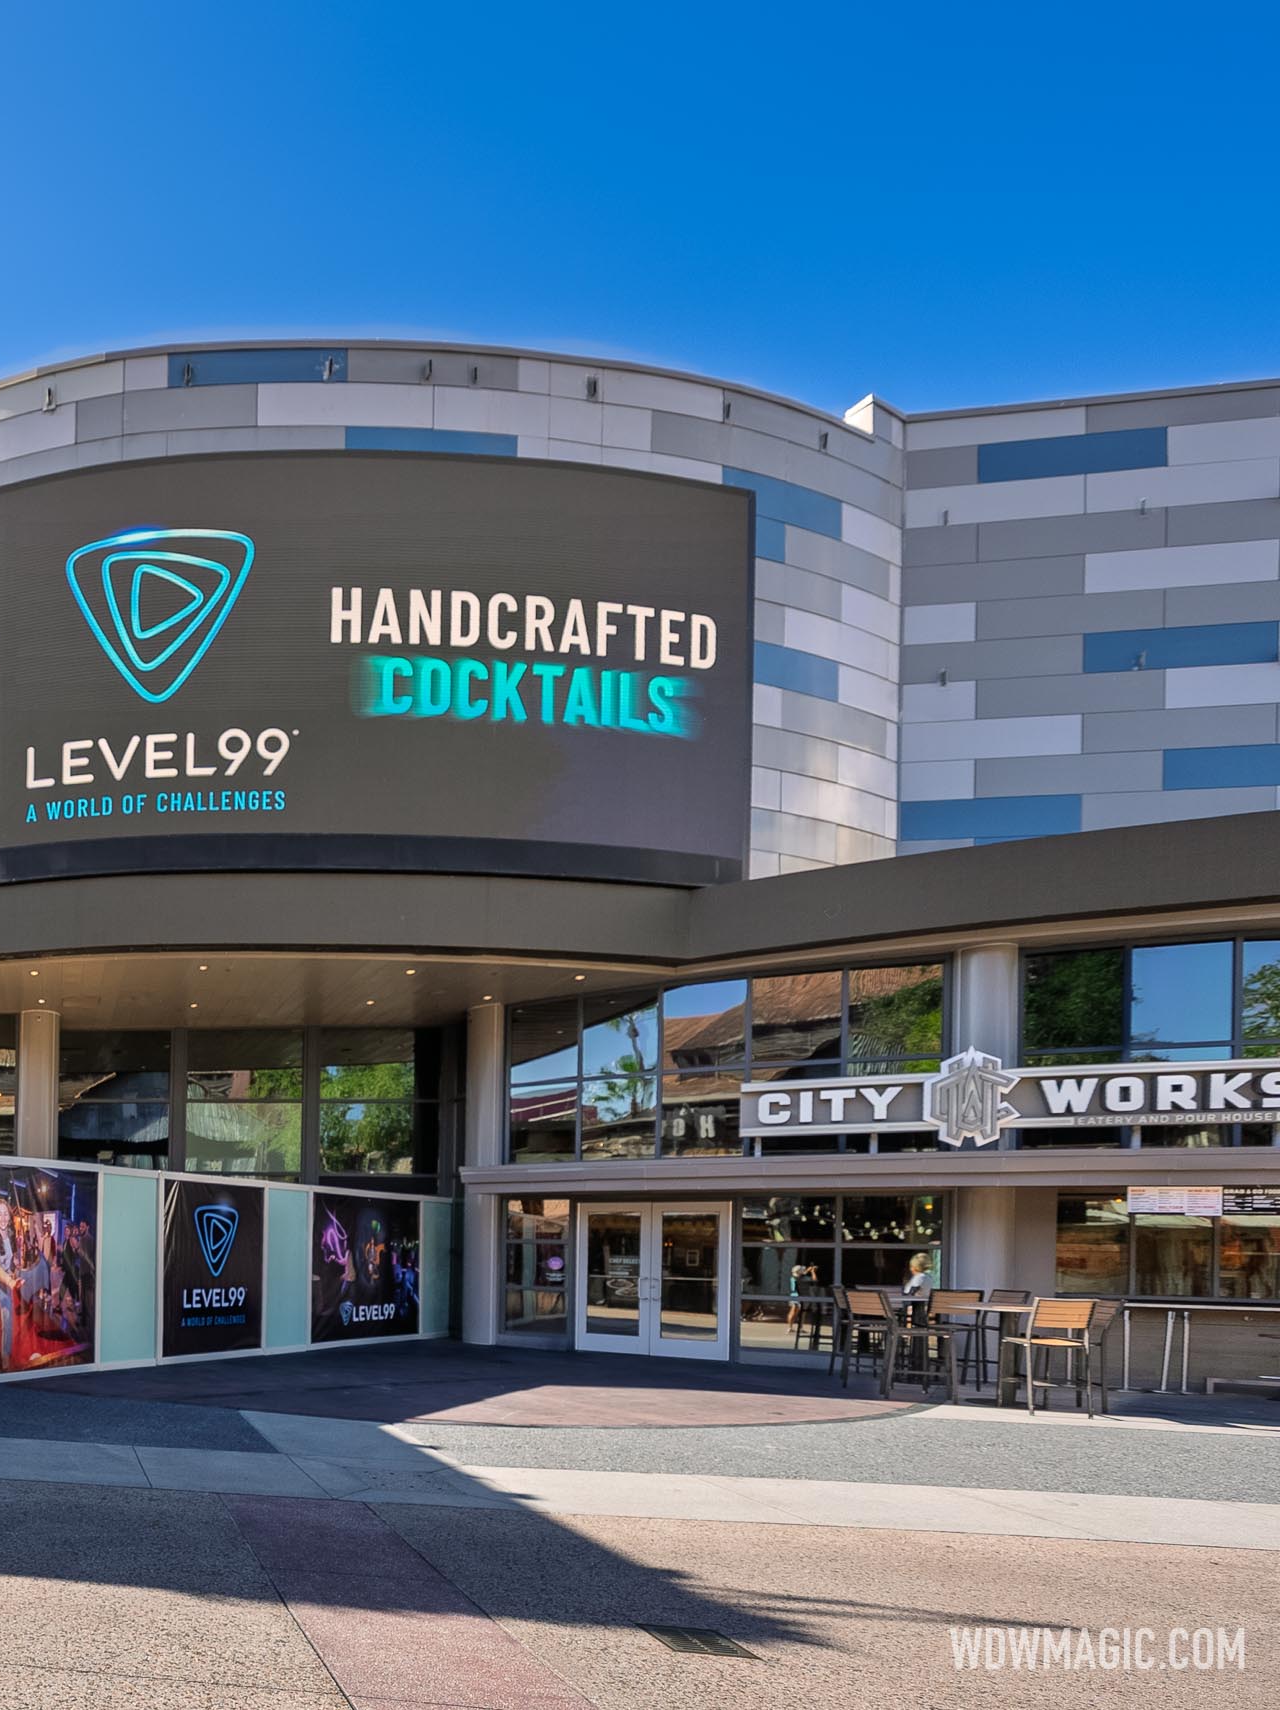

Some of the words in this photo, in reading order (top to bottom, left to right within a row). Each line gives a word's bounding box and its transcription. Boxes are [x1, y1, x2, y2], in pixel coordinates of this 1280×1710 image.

[330, 586, 718, 670] HANDCRAFTED
[368, 655, 686, 736] COCKTAILS
[25, 727, 290, 789] LEVEL99
[25, 803, 38, 823] A
[45, 796, 113, 821] WORLD
[122, 794, 148, 815] OF
[156, 789, 287, 813] CHALLENGES
[757, 1086, 904, 1125] CITY
[1077, 1115, 1134, 1127] EATERY
[1138, 1114, 1170, 1125] AND
[1175, 1112, 1217, 1124] POUR
[1221, 1111, 1273, 1122] HOUSE
[182, 1287, 245, 1309] LEVEL99
[352, 1303, 396, 1322] LEVEL99
